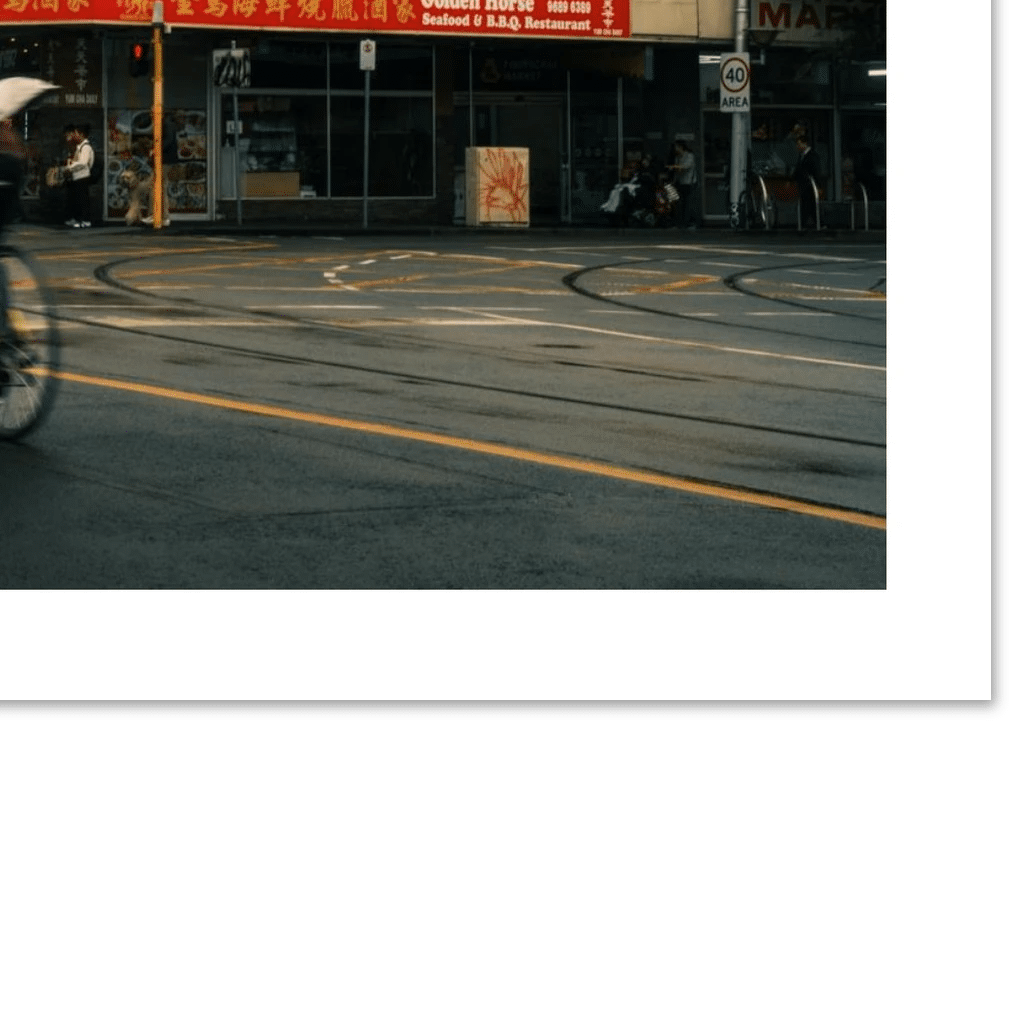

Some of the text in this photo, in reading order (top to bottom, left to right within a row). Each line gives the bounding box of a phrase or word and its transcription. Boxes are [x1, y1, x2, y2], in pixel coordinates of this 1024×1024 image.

[422, 12, 591, 31] Seafood & B.B.Q. Restaurant
[725, 67, 745, 83] 40
[722, 96, 748, 107] AREA
